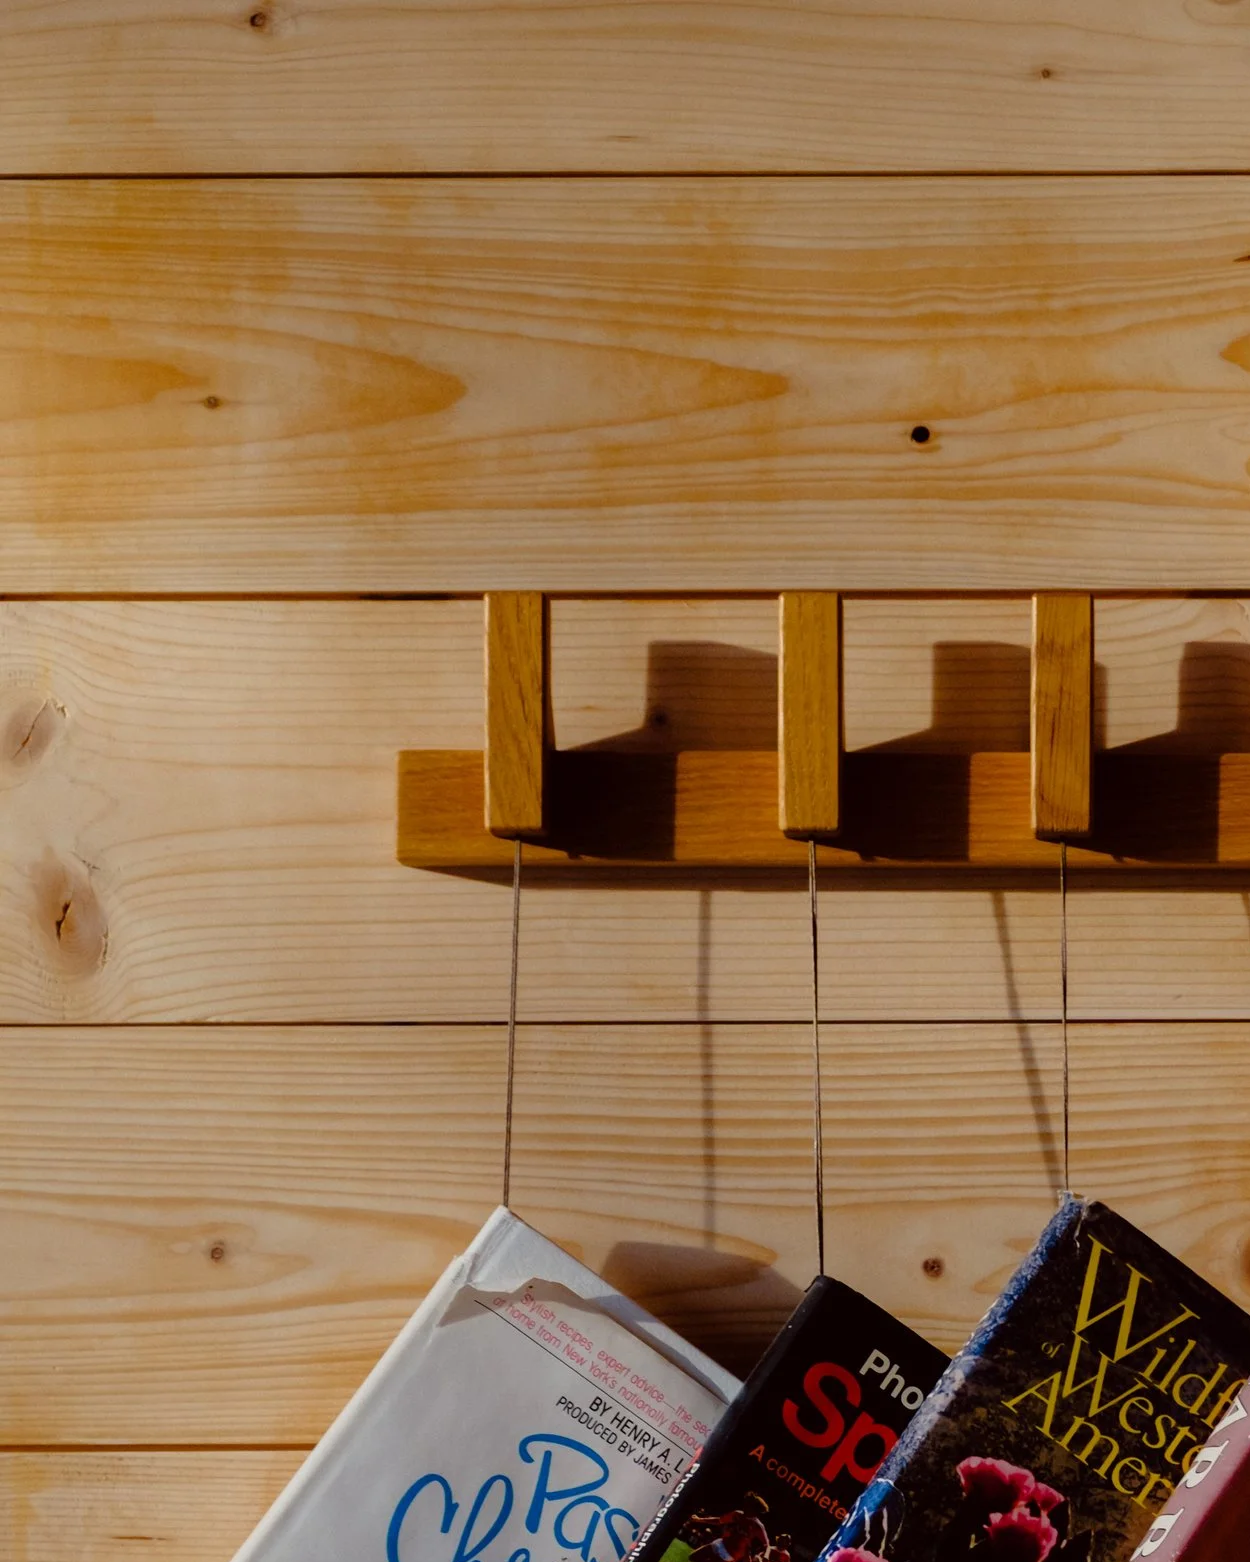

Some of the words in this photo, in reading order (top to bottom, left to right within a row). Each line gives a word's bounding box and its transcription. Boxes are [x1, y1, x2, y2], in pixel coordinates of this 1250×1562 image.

[505, 1301, 537, 1330] home
[536, 1324, 561, 1348] from
[562, 1343, 588, 1366] New
[618, 1386, 668, 1428] nationally
[520, 1292, 557, 1324] Stylish
[556, 1320, 594, 1354] recipes,
[597, 1350, 632, 1377] expert
[1040, 1341, 1065, 1360] of
[858, 1348, 925, 1411] Pho
[555, 1395, 618, 1445] PRODUCED
[617, 1440, 637, 1457] BY
[633, 1453, 673, 1485] JAMES
[589, 1396, 613, 1417] BY
[610, 1412, 661, 1452] HENRY
[657, 1447, 671, 1466] A.
[782, 1361, 900, 1485] Sp
[748, 1443, 767, 1464] A
[766, 1457, 850, 1522] complete
